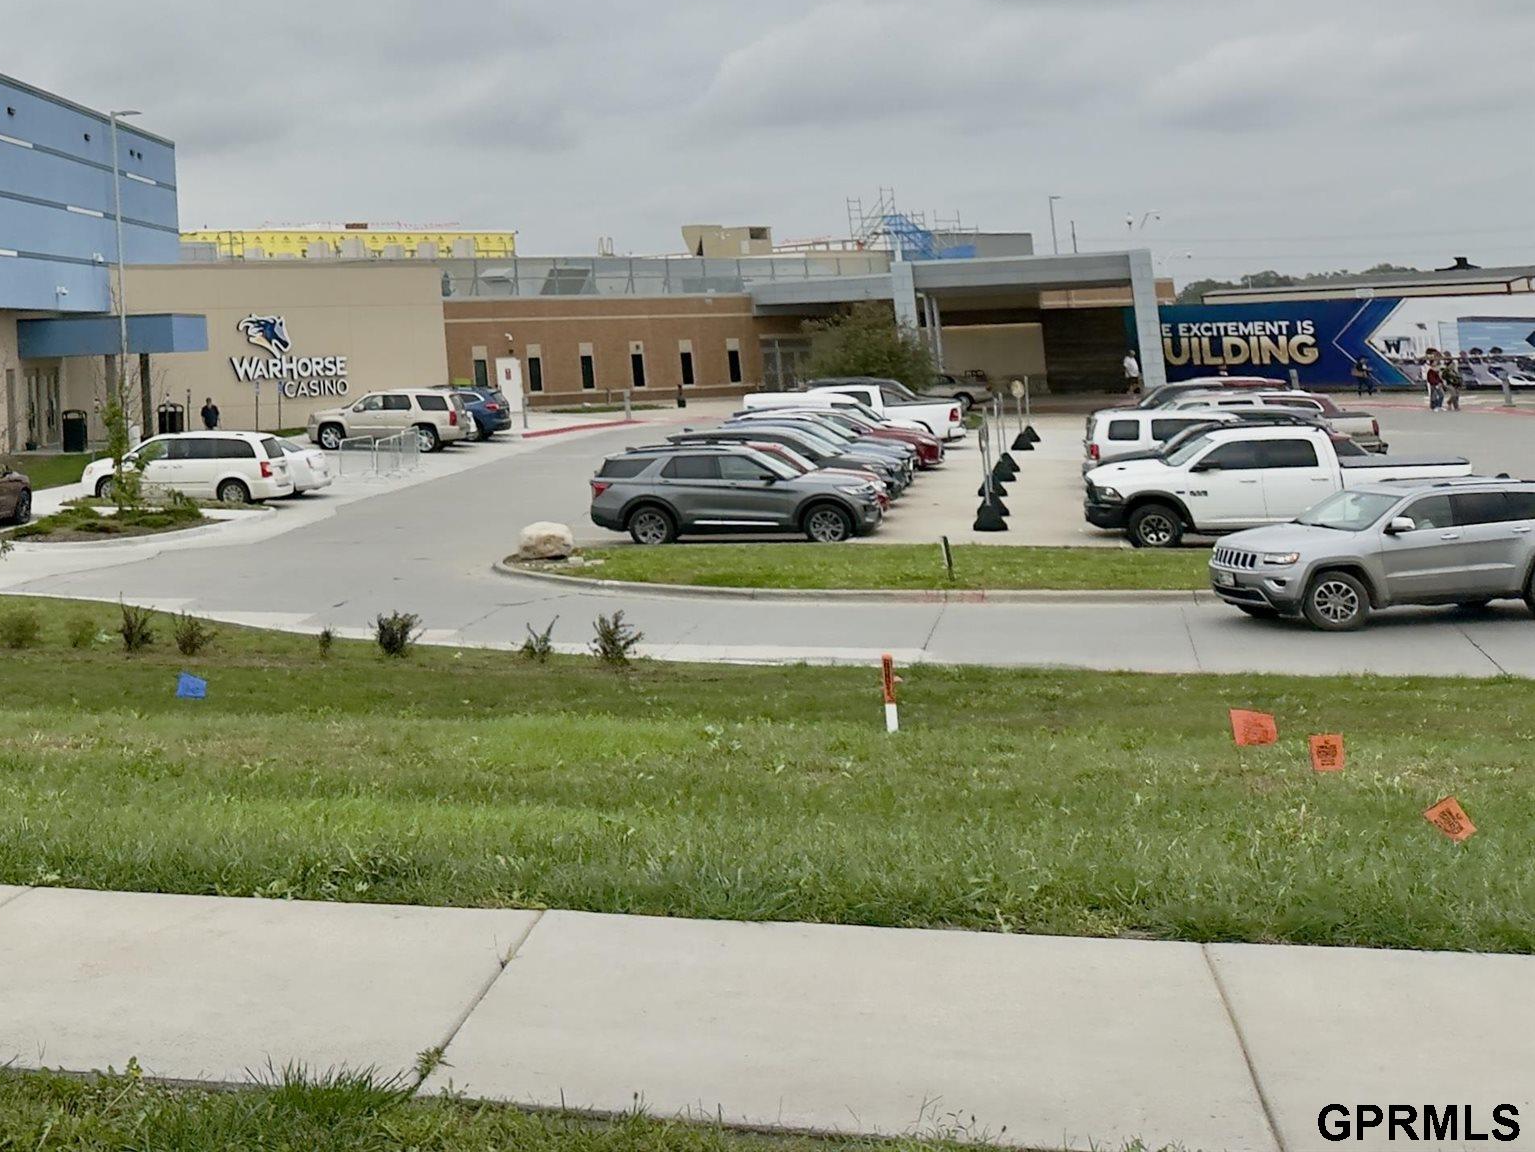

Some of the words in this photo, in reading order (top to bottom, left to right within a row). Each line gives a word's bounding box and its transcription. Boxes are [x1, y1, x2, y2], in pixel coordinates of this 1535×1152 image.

[1161, 323, 1172, 337] E
[1178, 321, 1289, 336] EXCITEMENT
[1296, 320, 1314, 334] IS
[1164, 335, 1319, 365] UILDING
[230, 355, 348, 381] WARHORSE
[283, 379, 349, 398] CASINO
